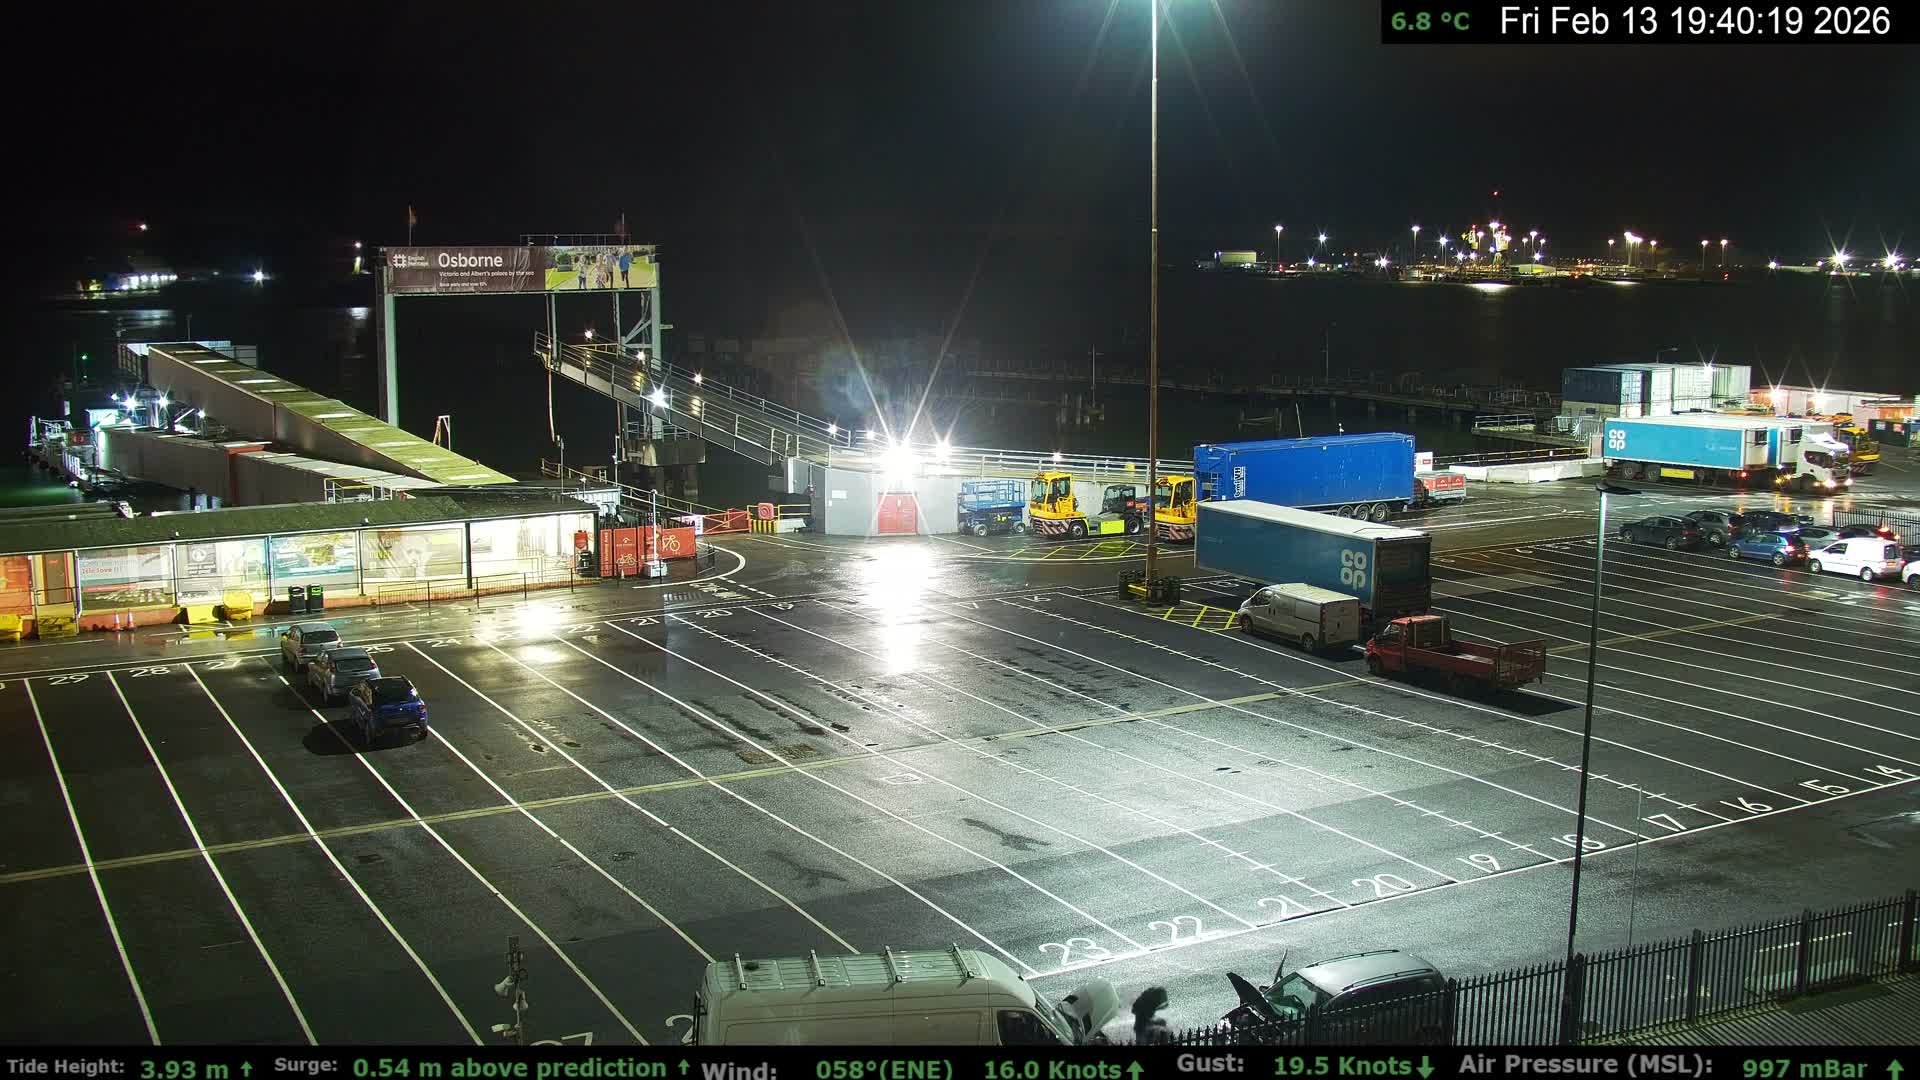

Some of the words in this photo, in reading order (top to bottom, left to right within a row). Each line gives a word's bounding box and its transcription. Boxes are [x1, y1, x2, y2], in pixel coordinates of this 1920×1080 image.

[438, 252, 503, 268] Osborne
[630, 617, 660, 626] 21
[696, 609, 733, 618] 20
[129, 666, 170, 678] 28
[207, 658, 241, 670] 27
[47, 673, 90, 686] 29
[1864, 764, 1915, 781] 14
[1799, 779, 1850, 796] 15
[1720, 797, 1773, 814] 16
[1642, 813, 1687, 832] 17
[1456, 852, 1500, 873] 19
[1352, 873, 1416, 898] 20
[1258, 894, 1318, 920] 21
[1148, 915, 1222, 946] 22
[1039, 937, 1111, 967] 23
